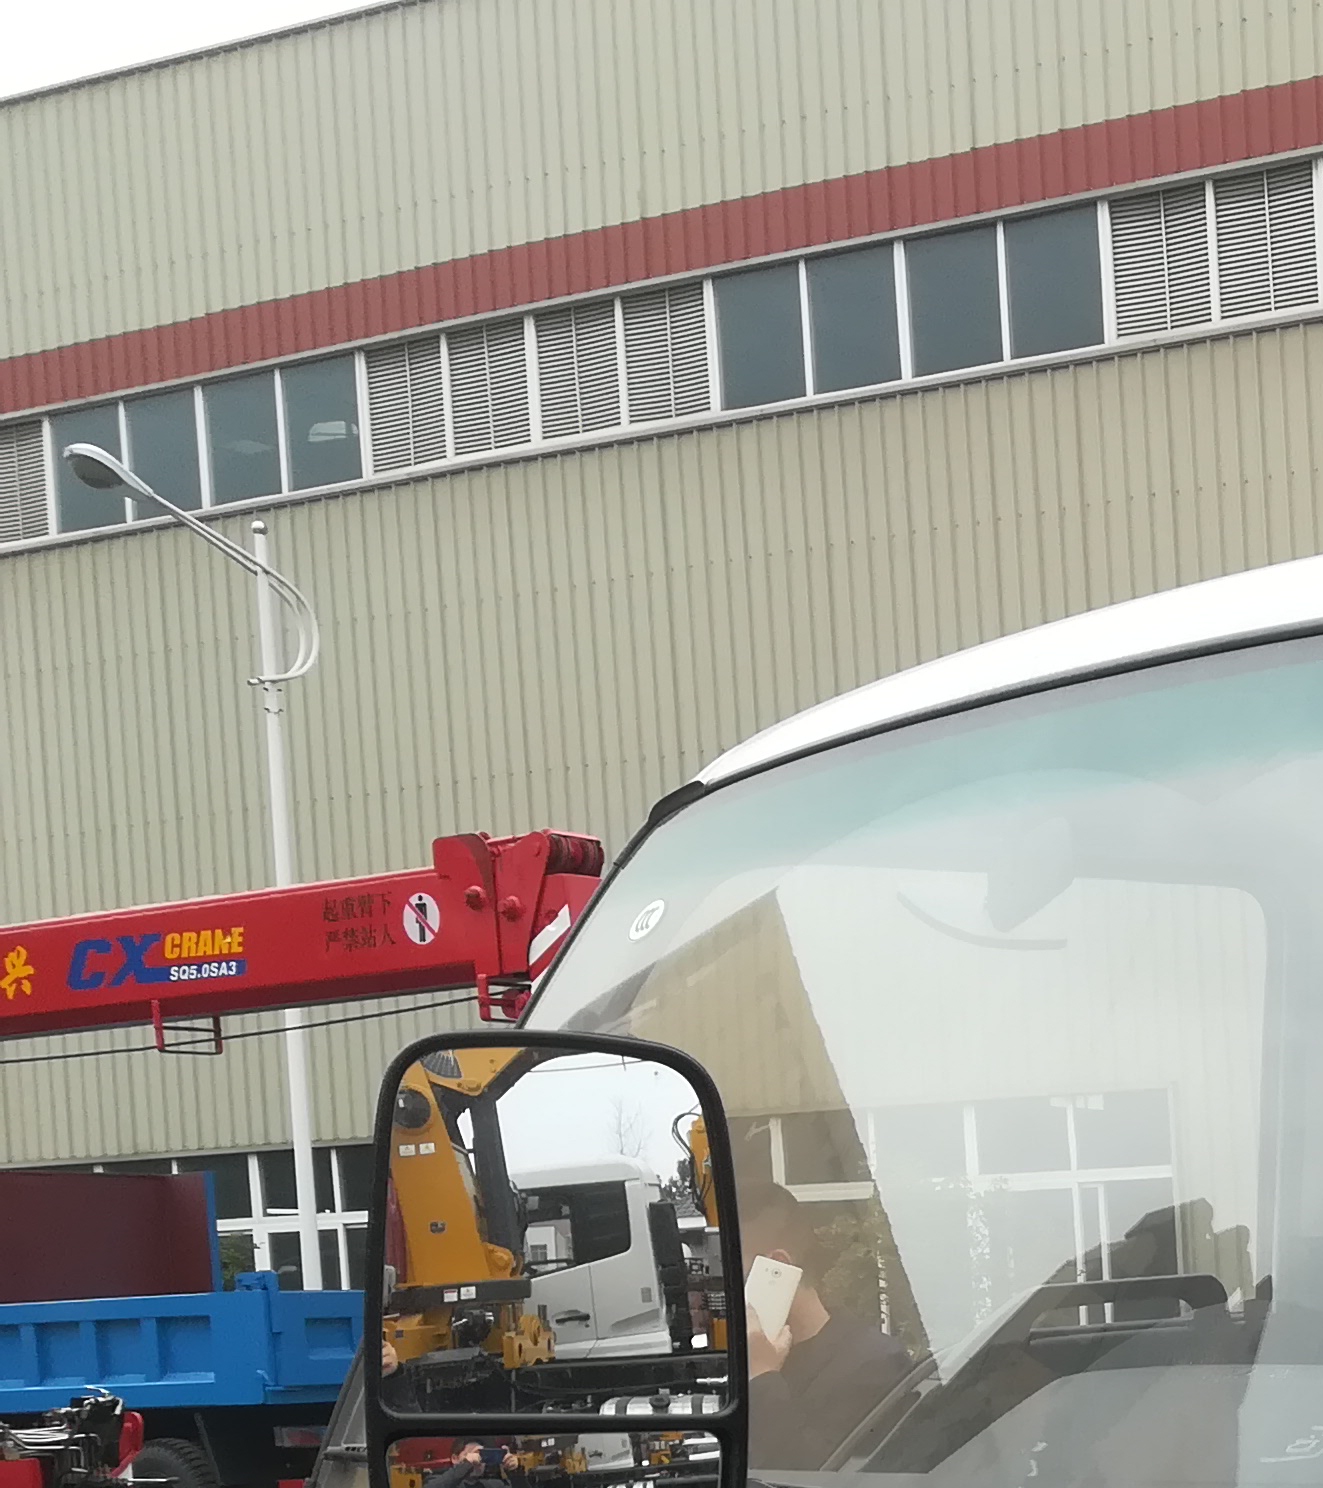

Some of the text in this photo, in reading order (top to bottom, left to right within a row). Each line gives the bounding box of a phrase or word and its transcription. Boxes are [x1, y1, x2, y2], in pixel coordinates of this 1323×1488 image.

[323, 891, 392, 922] 起重臂下
[325, 923, 397, 953] 严禁站人
[67, 926, 244, 990] CX CRANE
